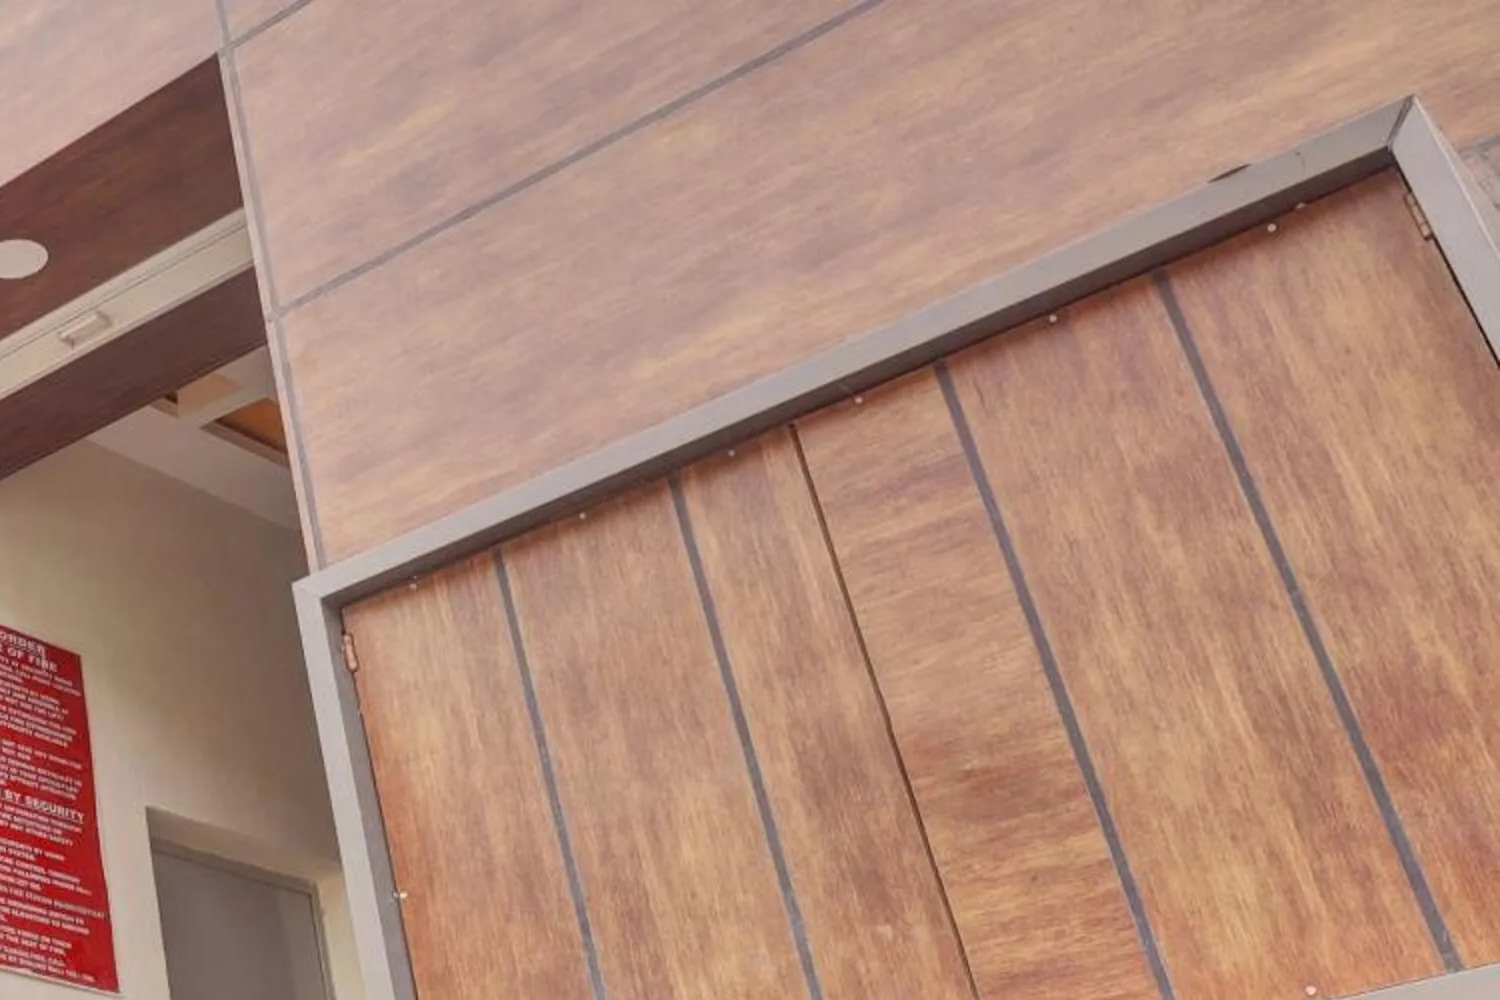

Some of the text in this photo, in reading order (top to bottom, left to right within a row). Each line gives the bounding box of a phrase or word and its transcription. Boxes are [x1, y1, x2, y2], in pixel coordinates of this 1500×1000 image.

[7, 646, 26, 660] OF
[27, 654, 59, 673] FIRE
[4, 789, 21, 803] BY
[24, 795, 85, 826] SECURITY
